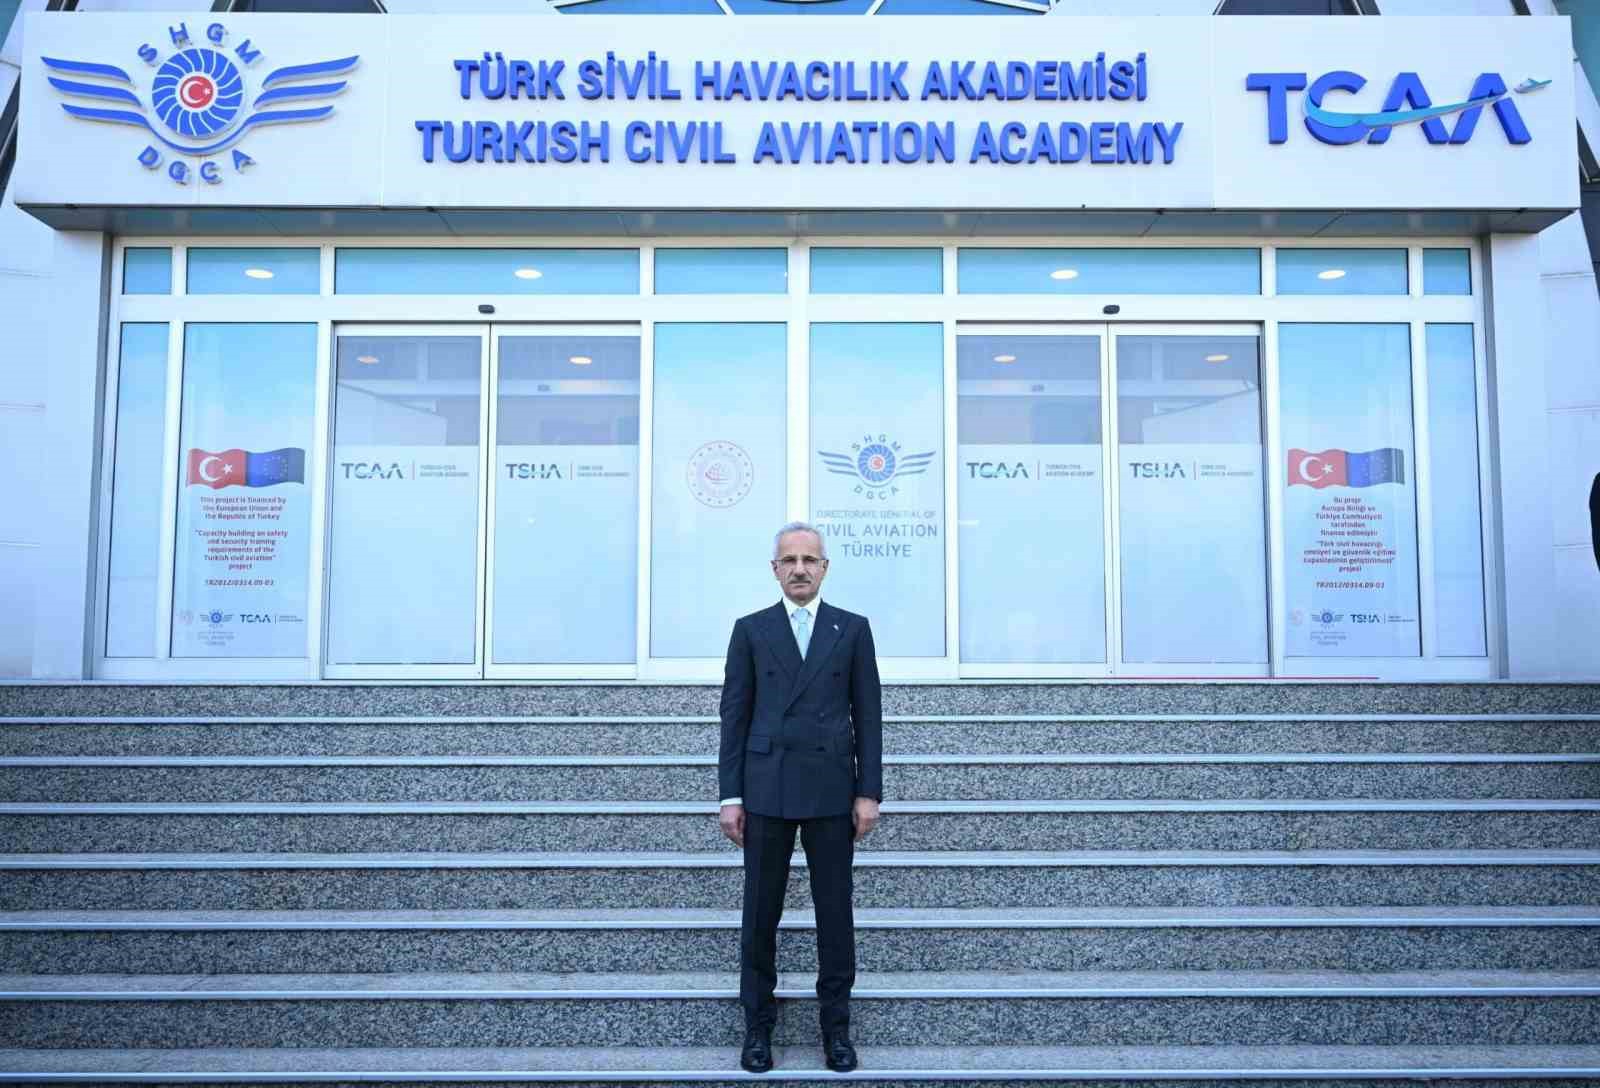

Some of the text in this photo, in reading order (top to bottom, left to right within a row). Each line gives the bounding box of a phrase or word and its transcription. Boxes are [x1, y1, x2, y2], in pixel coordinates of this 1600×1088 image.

[137, 22, 263, 67] SHGM
[454, 51, 1147, 101] TÜRK SİVİL HAVACILIK AKADEMİSİ
[1246, 70, 1532, 145] TCAA
[415, 120, 1183, 165] TURKISH CIVIL AVIATION ACADEMY
[137, 145, 256, 185] DGCA
[341, 463, 404, 479] TCAA
[505, 463, 563, 479] TSHA
[966, 462, 1029, 479] TCAA
[1129, 462, 1186, 479] TSHA
[862, 524, 938, 537] AVIATION
[841, 540, 913, 557] TÜRKİYE
[240, 614, 271, 623] TCAA
